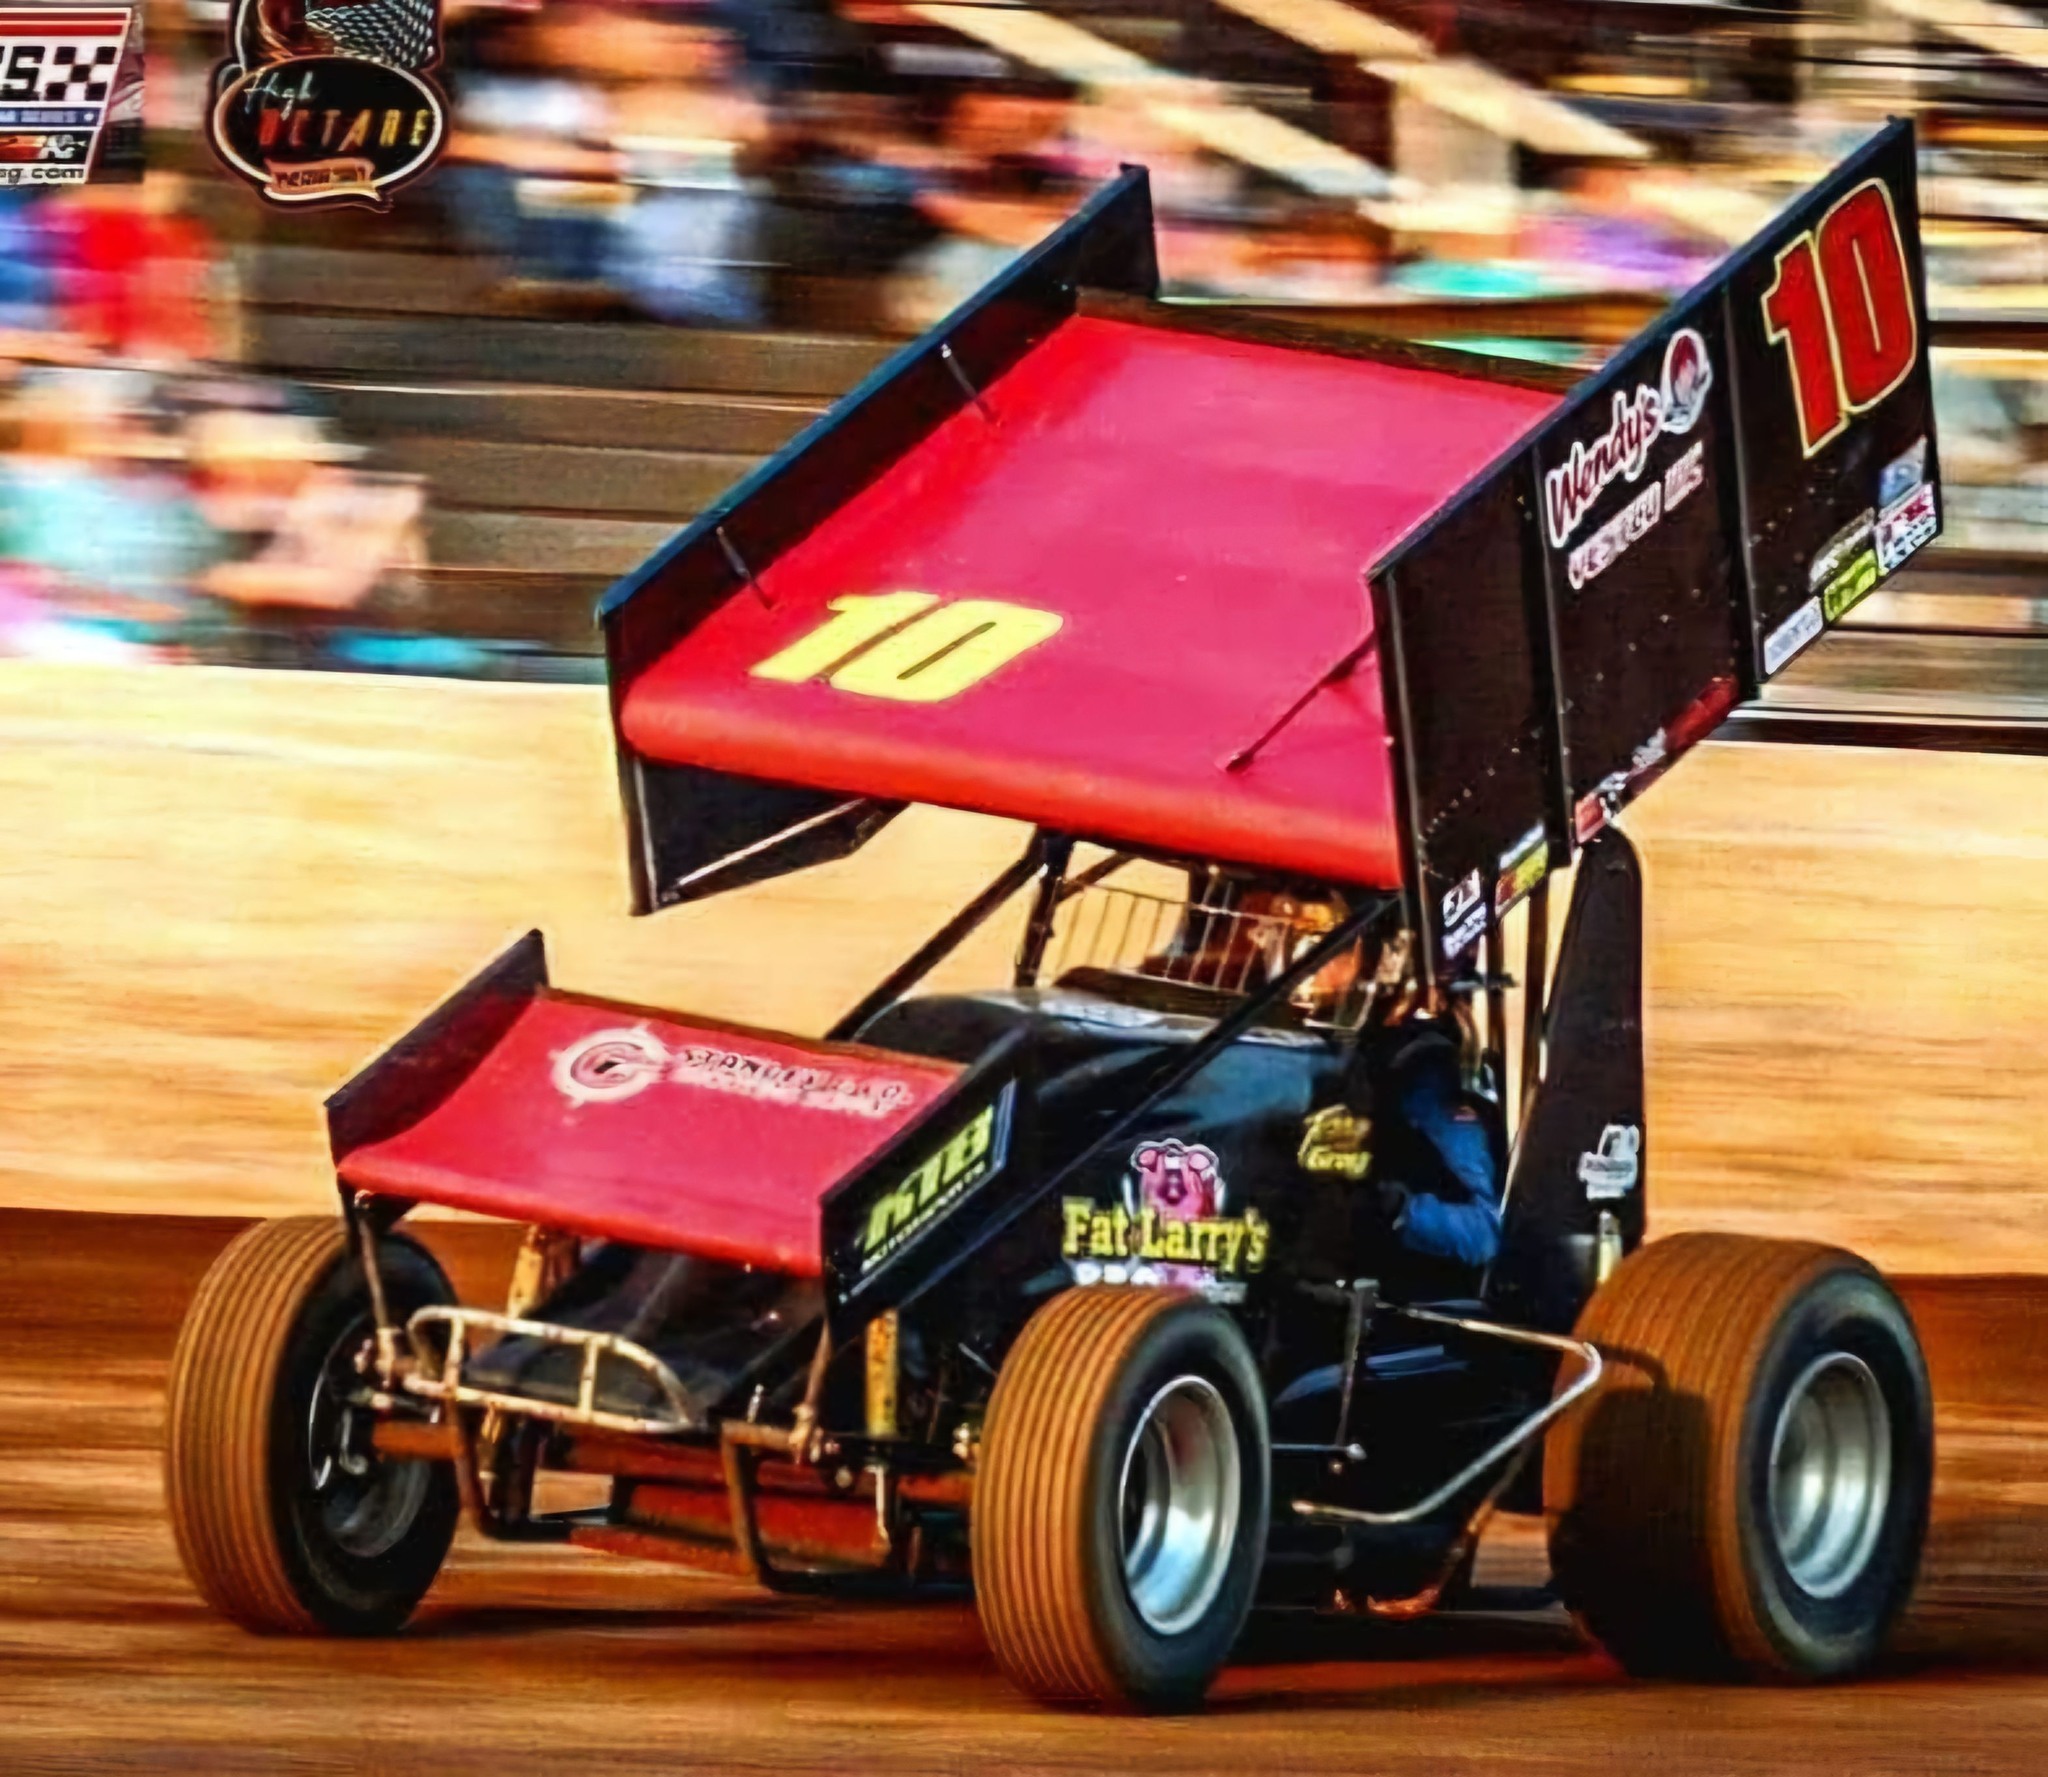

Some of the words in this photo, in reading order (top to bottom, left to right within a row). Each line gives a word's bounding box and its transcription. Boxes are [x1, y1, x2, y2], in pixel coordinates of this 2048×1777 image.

[1761, 178, 1917, 460] 10
[1546, 383, 1662, 548] Wendy's
[748, 591, 1064, 702] 10
[1062, 1197, 1129, 1257] Fat
[1140, 1206, 1270, 1274] Larry's
